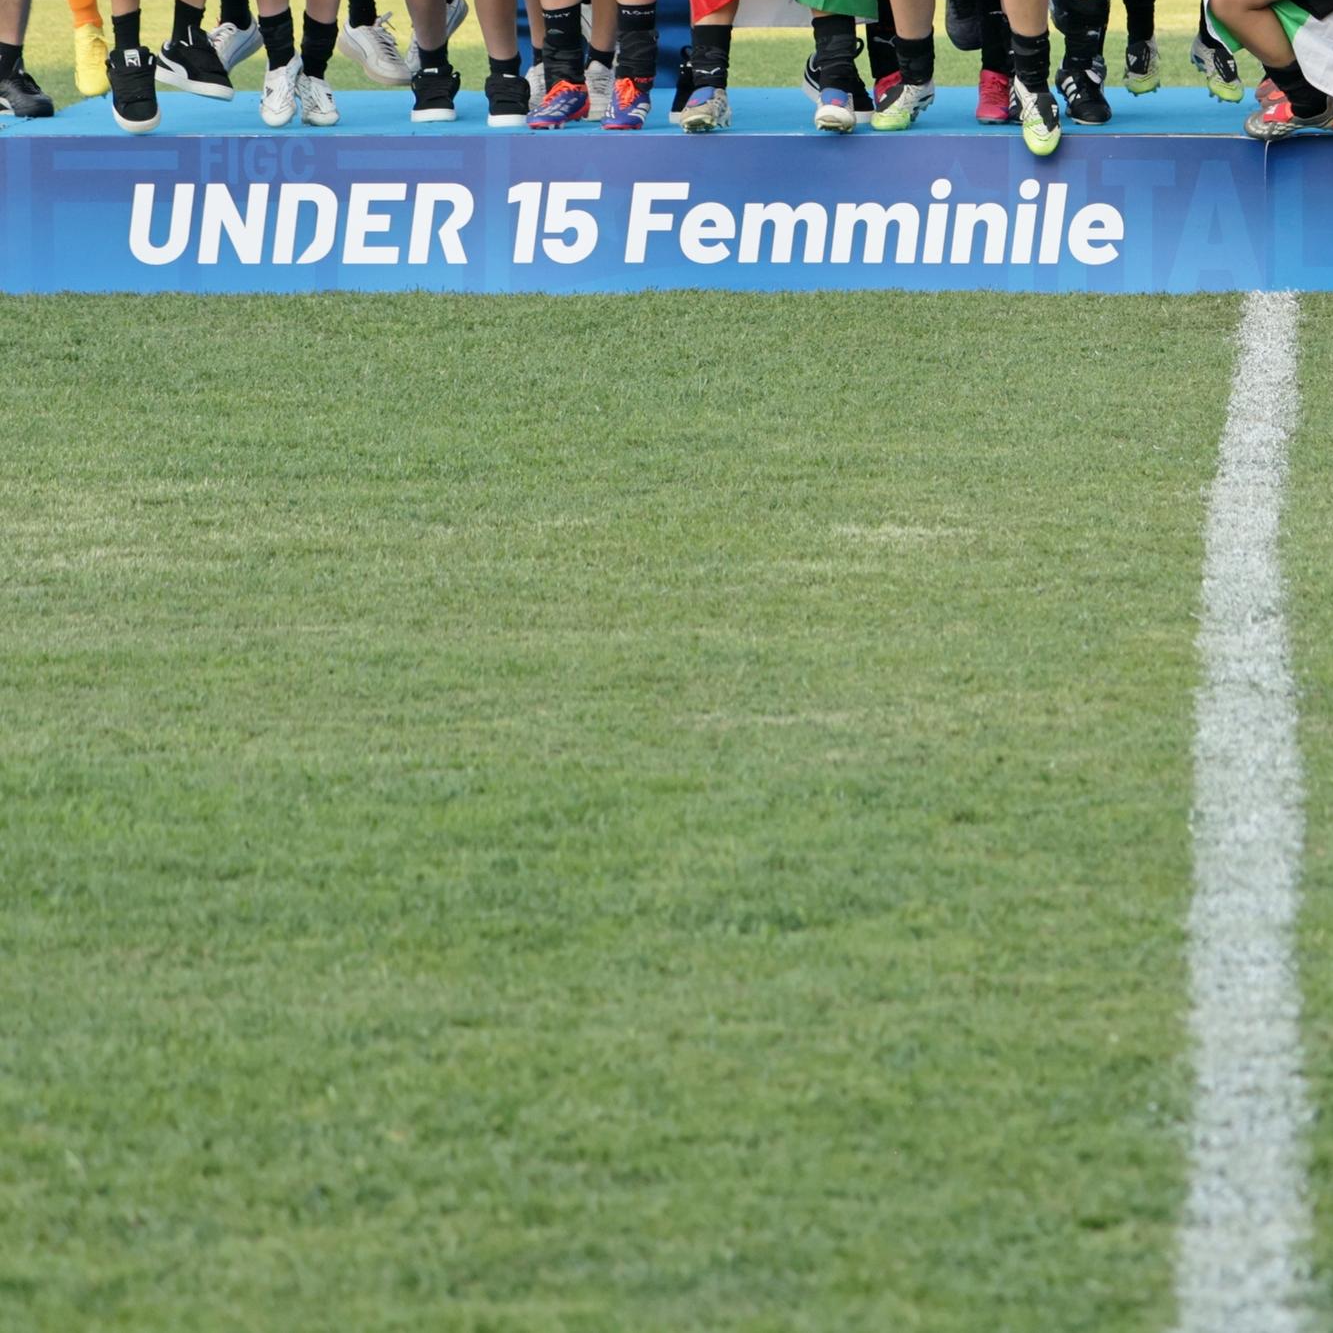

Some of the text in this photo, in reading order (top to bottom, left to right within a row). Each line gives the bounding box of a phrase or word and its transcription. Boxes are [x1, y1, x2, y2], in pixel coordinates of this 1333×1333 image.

[129, 178, 1125, 266] UNDER 15 Femminile
